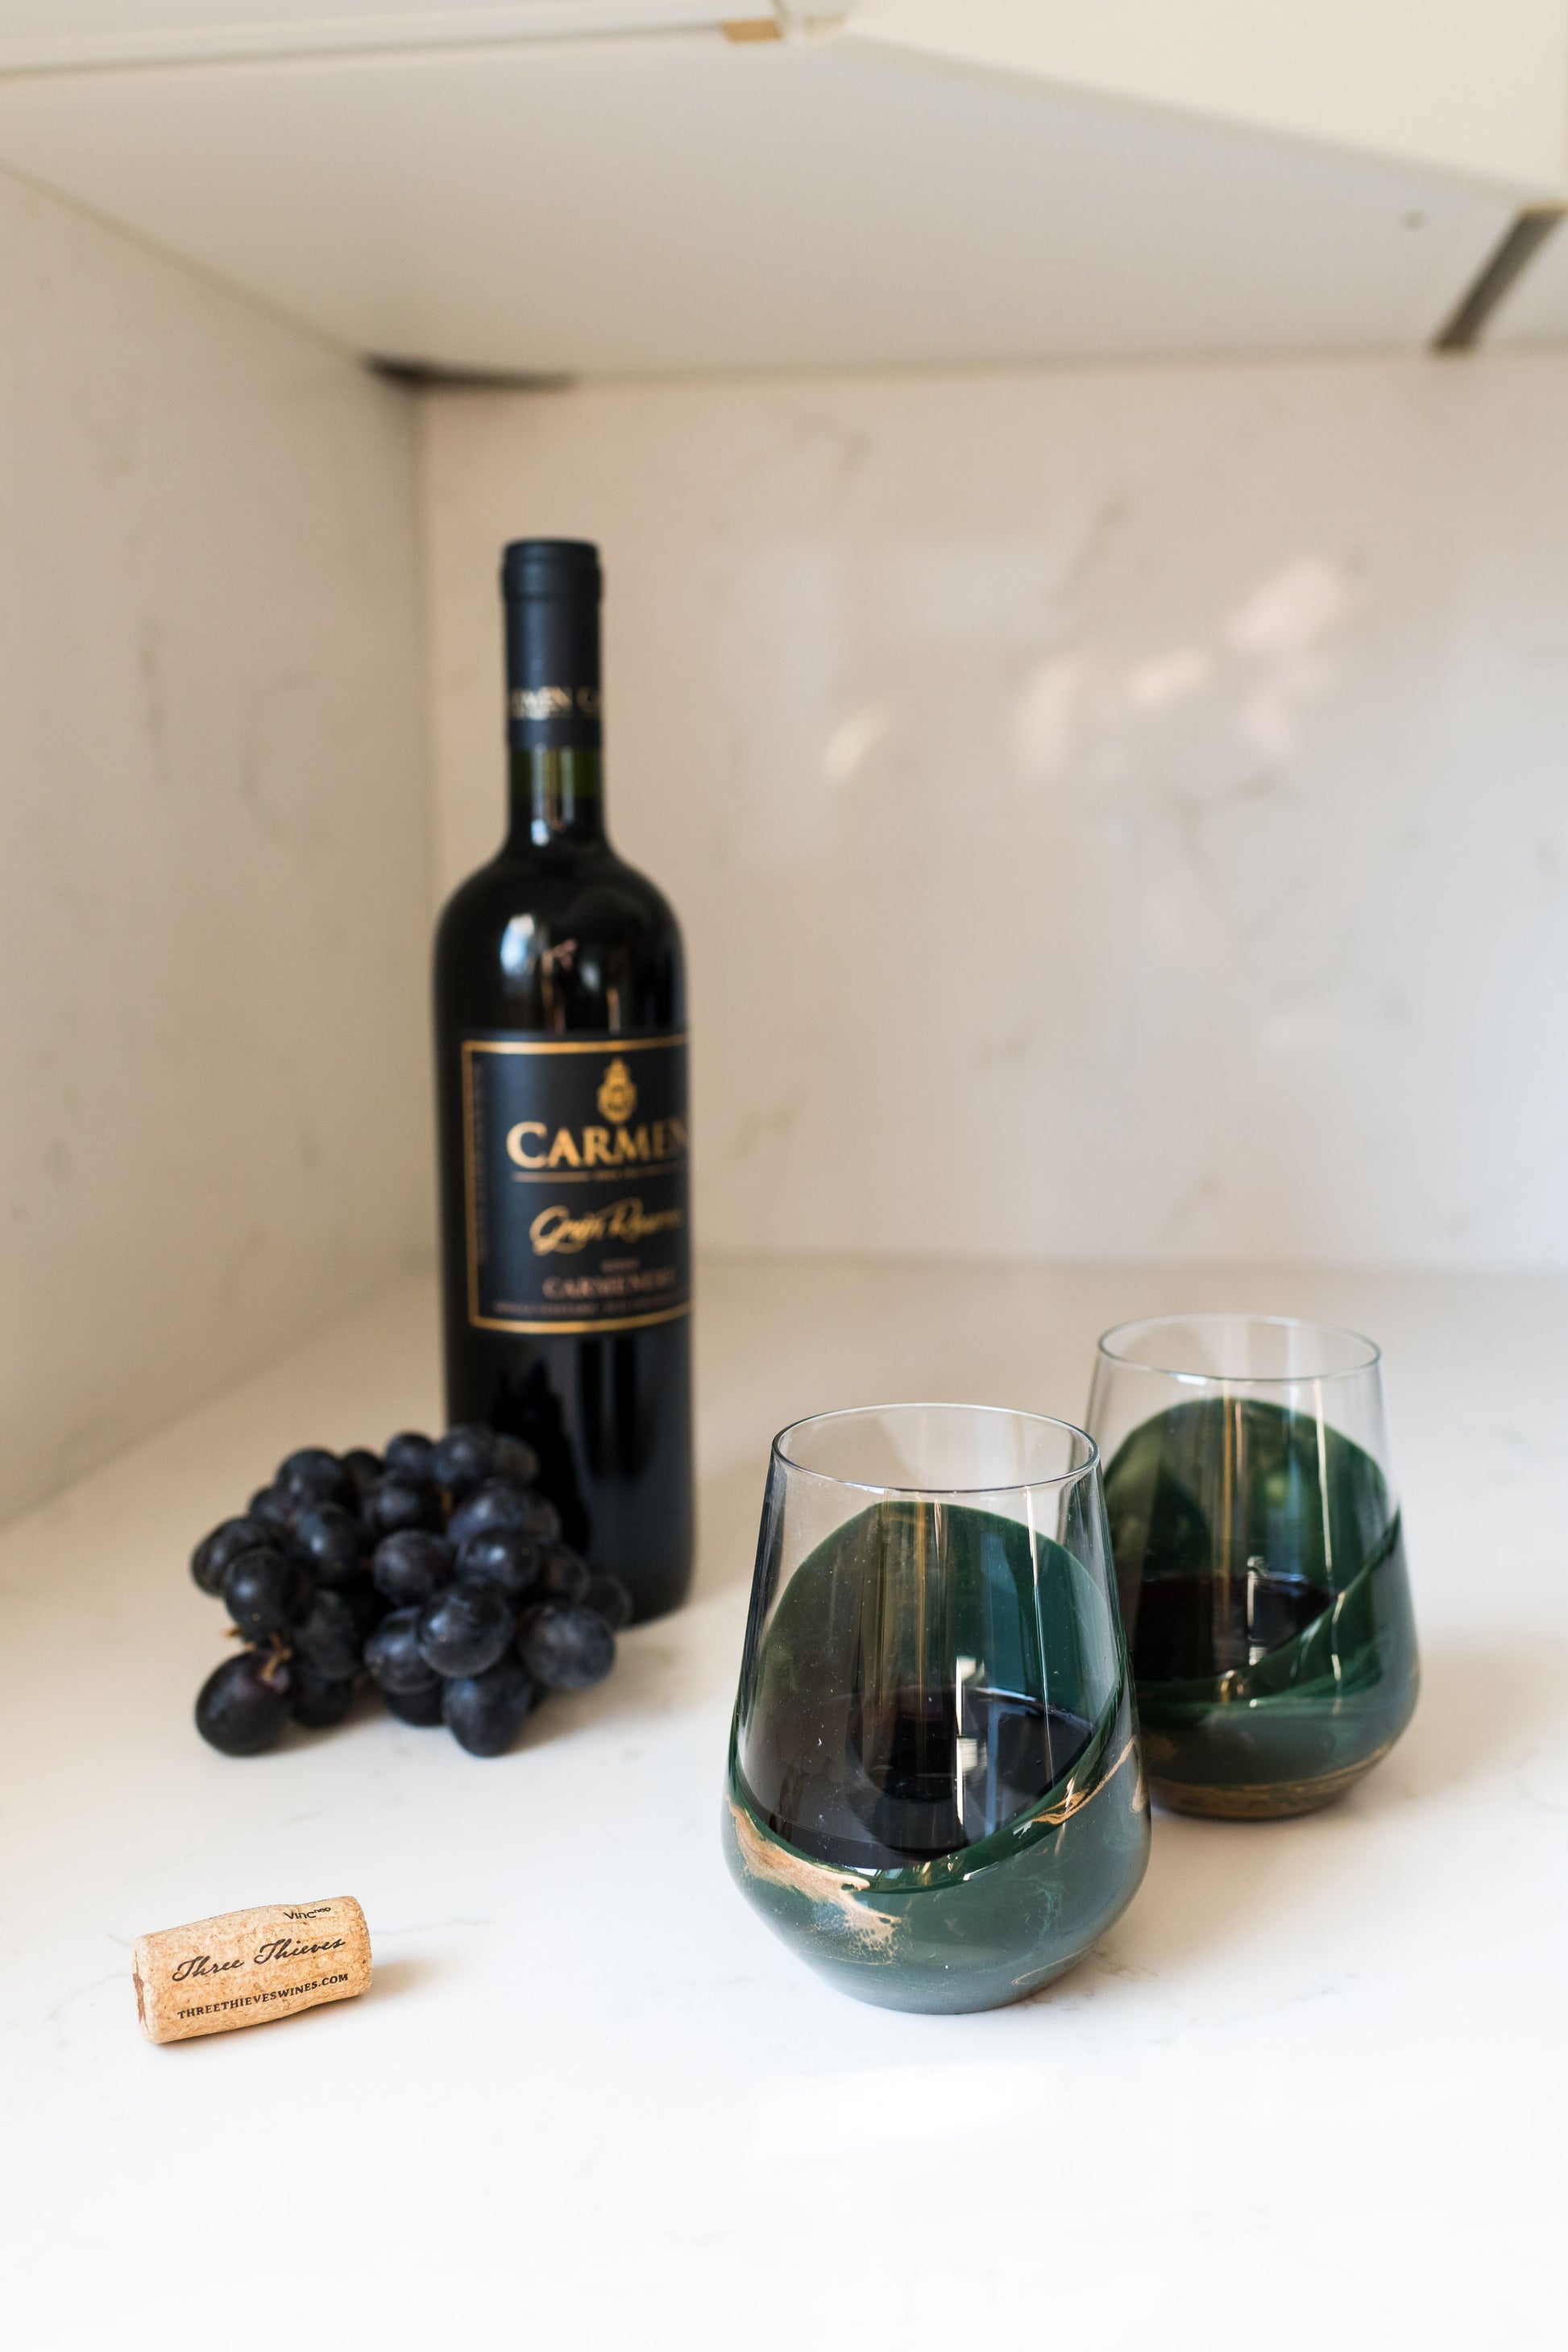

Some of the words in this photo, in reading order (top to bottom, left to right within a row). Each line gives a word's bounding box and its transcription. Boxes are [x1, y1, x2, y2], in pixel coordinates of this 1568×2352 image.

[172, 1956, 245, 1982] Three
[254, 1938, 346, 1965] Thieves
[176, 1973, 349, 2020] THREETHIEVESWINES.COM
